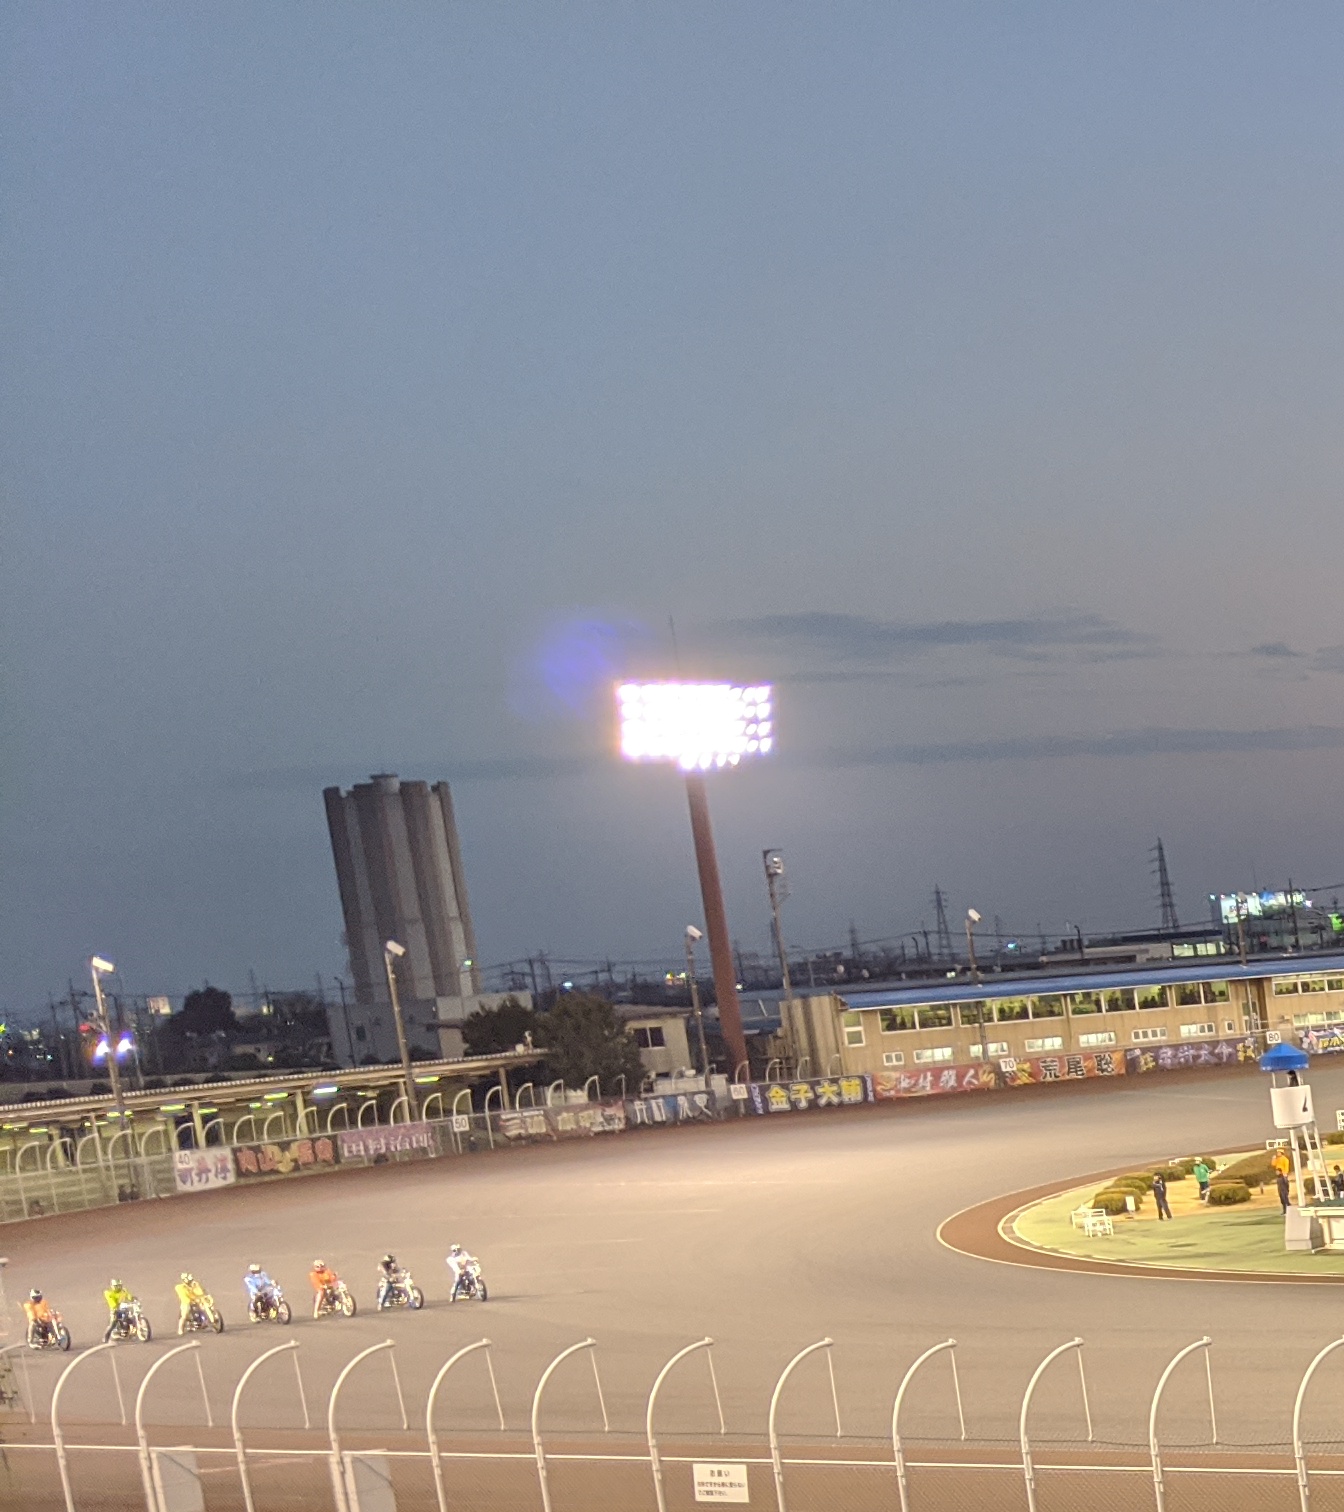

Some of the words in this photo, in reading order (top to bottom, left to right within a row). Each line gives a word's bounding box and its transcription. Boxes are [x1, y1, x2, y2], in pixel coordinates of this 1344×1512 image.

[1268, 1033, 1280, 1042] 80
[1002, 1058, 1015, 1070] 70
[768, 1078, 864, 1112] 金子大輔
[453, 1117, 468, 1129] 50
[177, 1152, 192, 1166] 40
